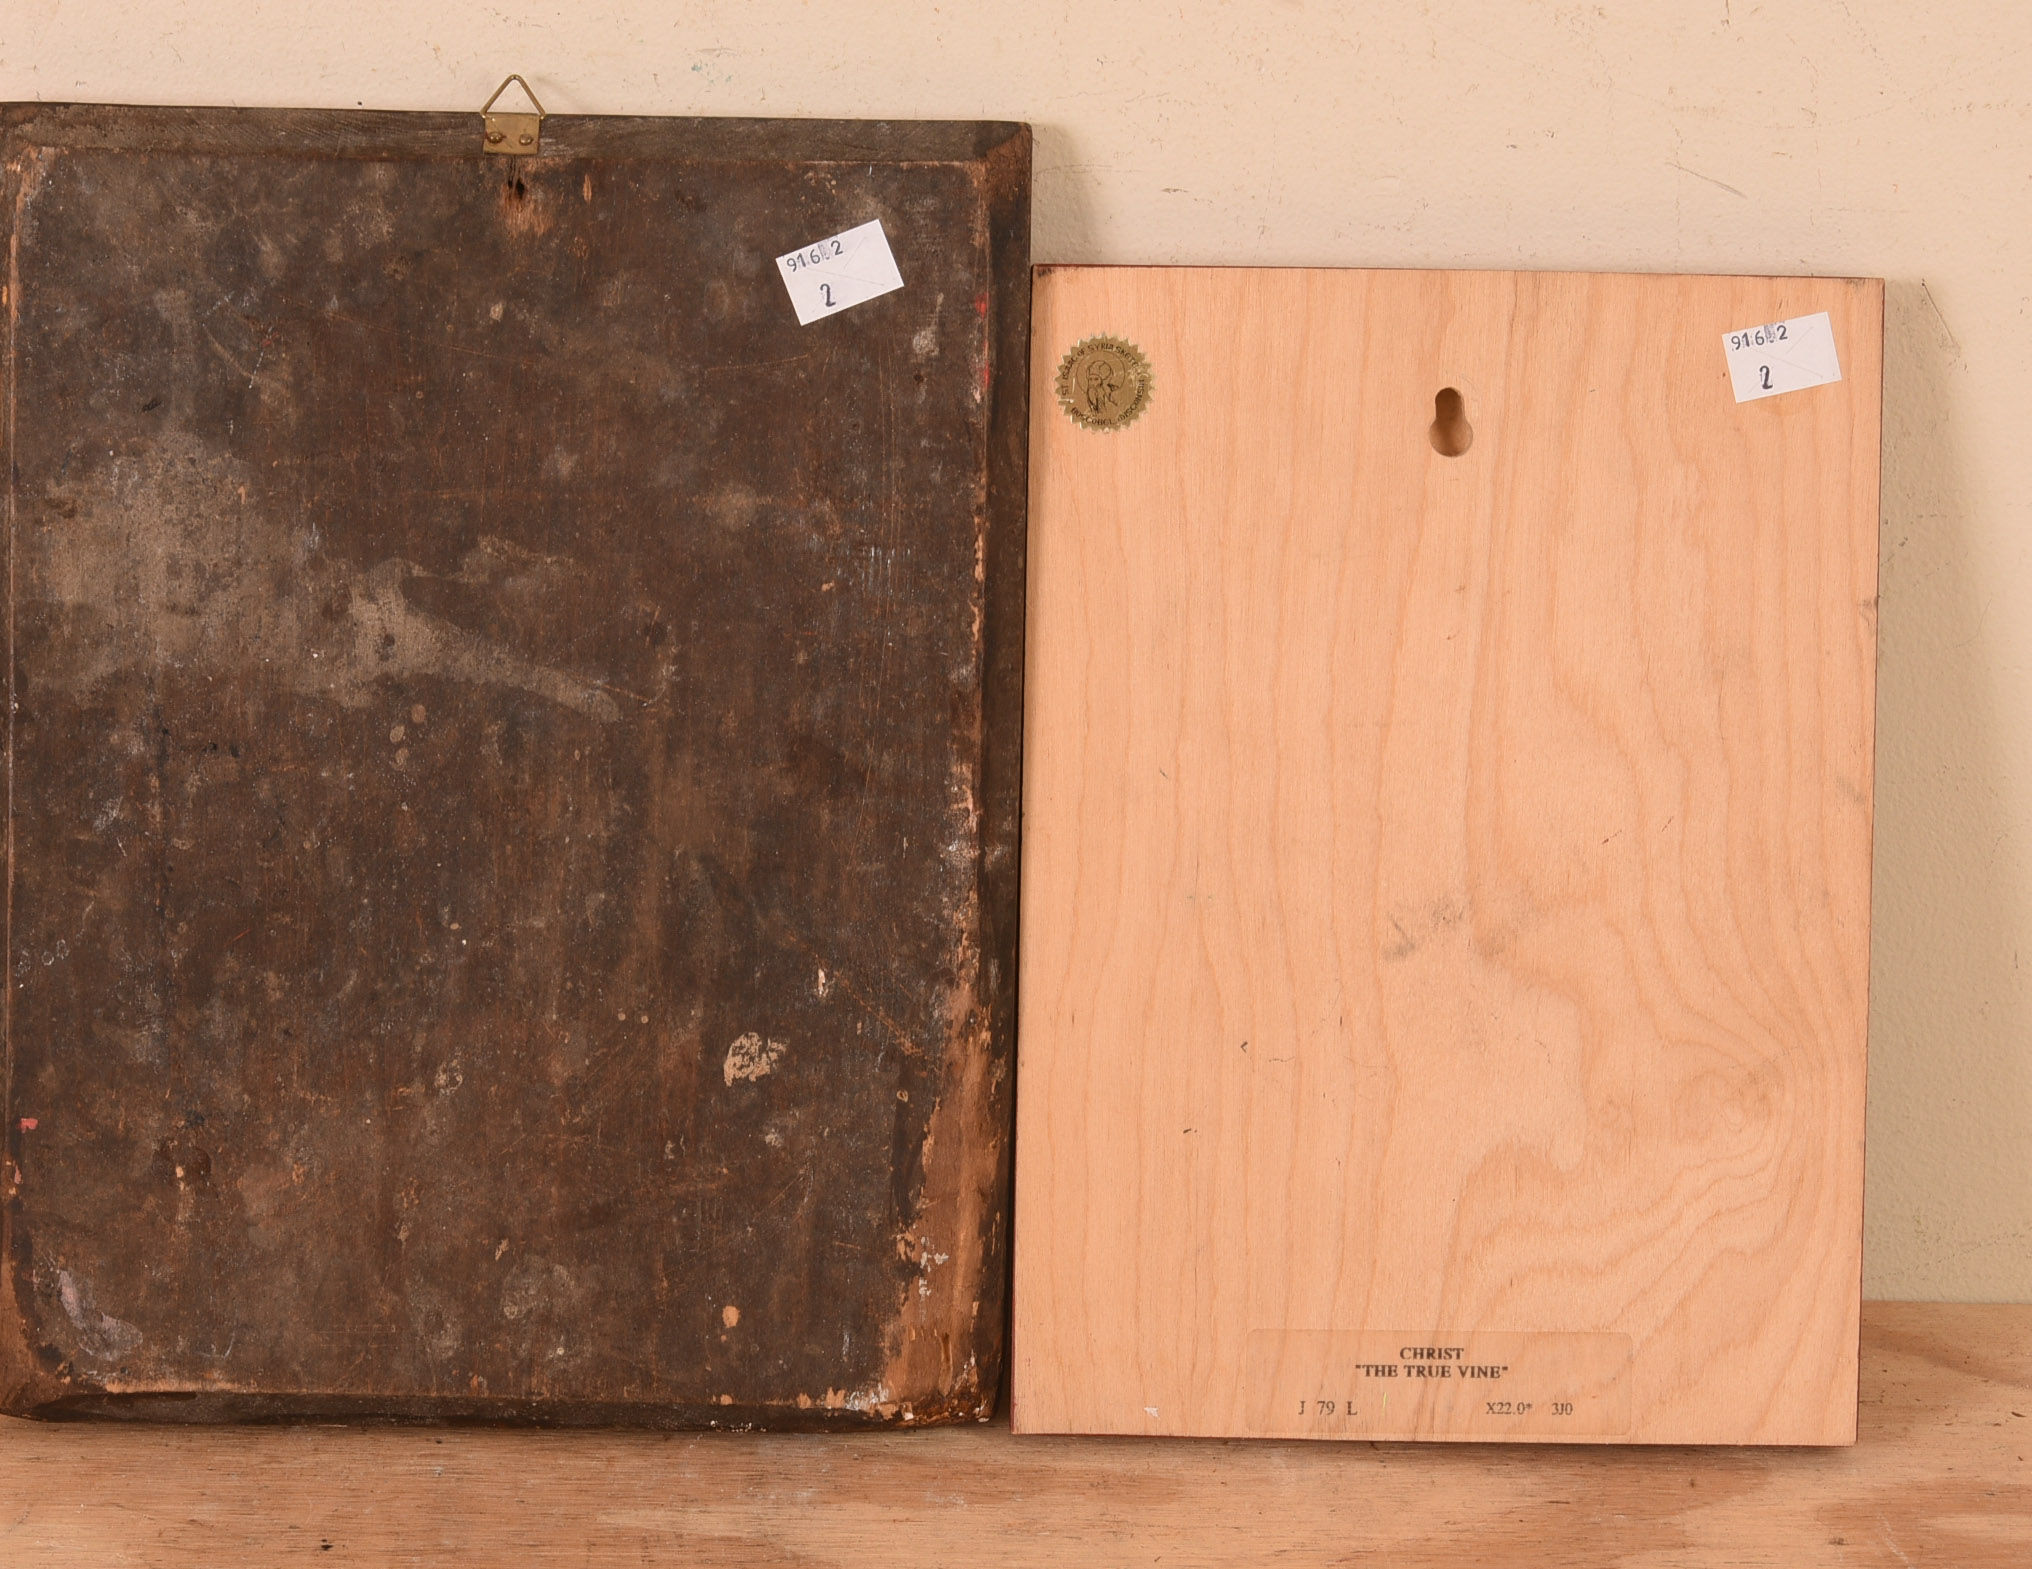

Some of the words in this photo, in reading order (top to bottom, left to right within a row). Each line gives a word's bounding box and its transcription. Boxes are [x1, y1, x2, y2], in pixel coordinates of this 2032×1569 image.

[819, 283, 836, 307] 2
[1077, 348, 1085, 357] OF
[1087, 343, 1115, 352] SYRIA
[1759, 365, 1773, 389] 2
[1399, 1347, 1465, 1361] CHRIST
[1354, 1364, 1399, 1378] "THE
[1403, 1364, 1452, 1379] TRUE
[1457, 1365, 1509, 1380] VINE"
[1297, 1400, 1306, 1416] J
[1316, 1400, 1336, 1416] 79
[1346, 1400, 1359, 1416] L
